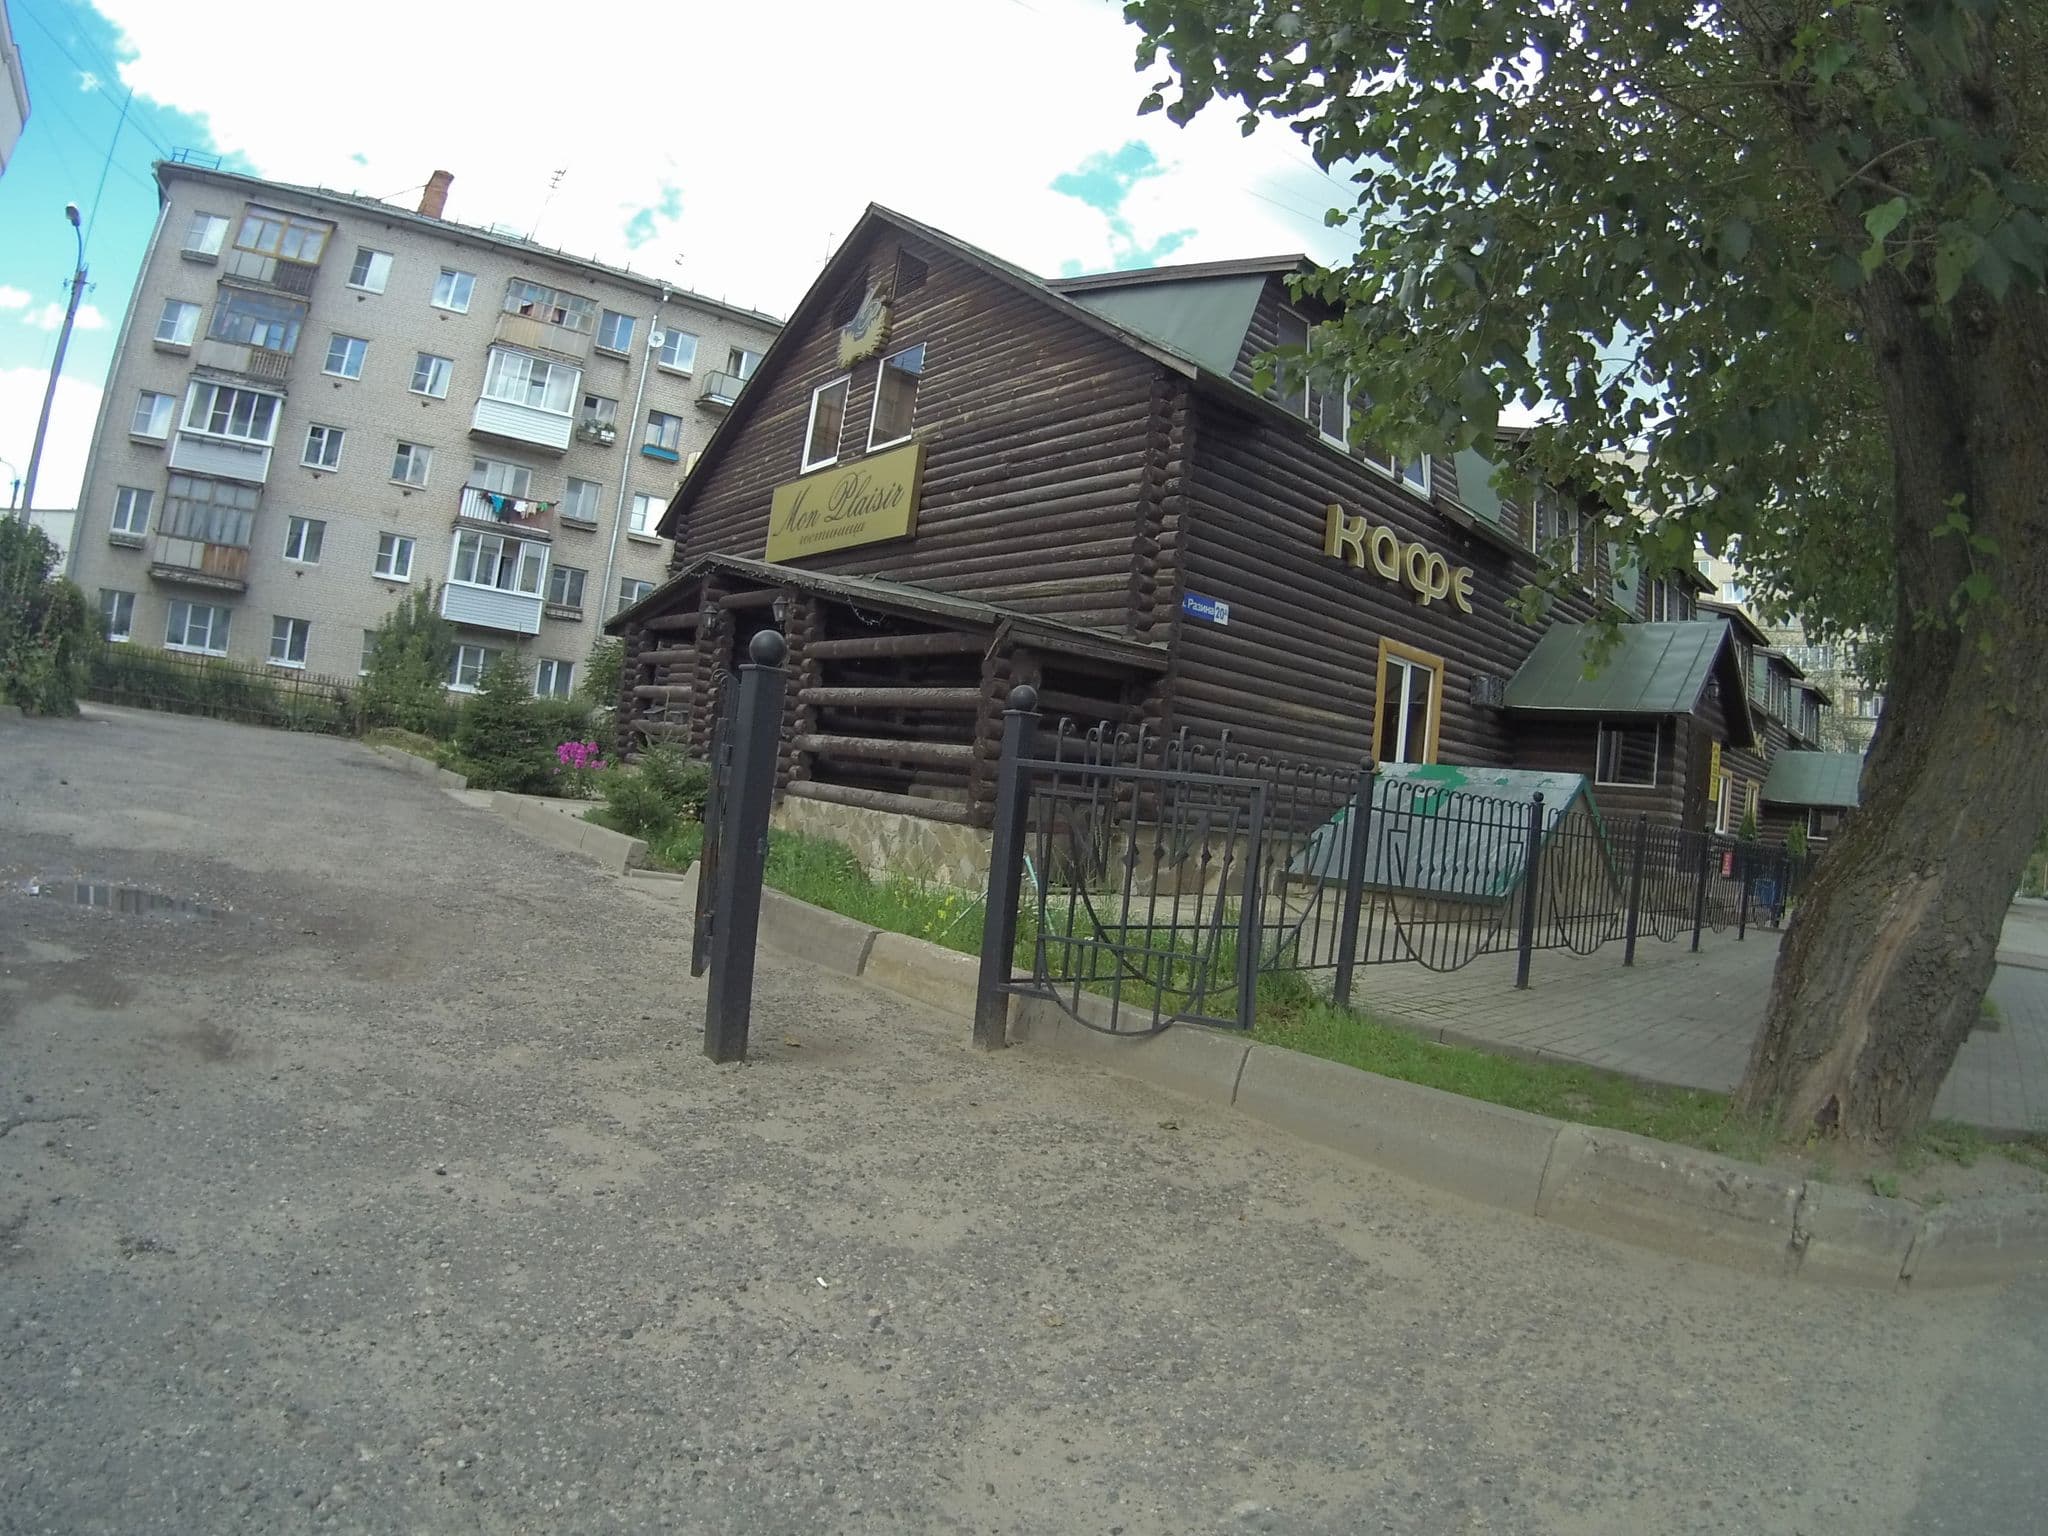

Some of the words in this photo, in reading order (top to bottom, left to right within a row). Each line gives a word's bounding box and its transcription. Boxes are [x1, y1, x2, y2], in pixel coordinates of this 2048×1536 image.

[772, 484, 821, 537] Mon
[824, 470, 905, 523] Plaisir
[800, 522, 866, 545] гостиница
[1187, 598, 1215, 616] Разина
